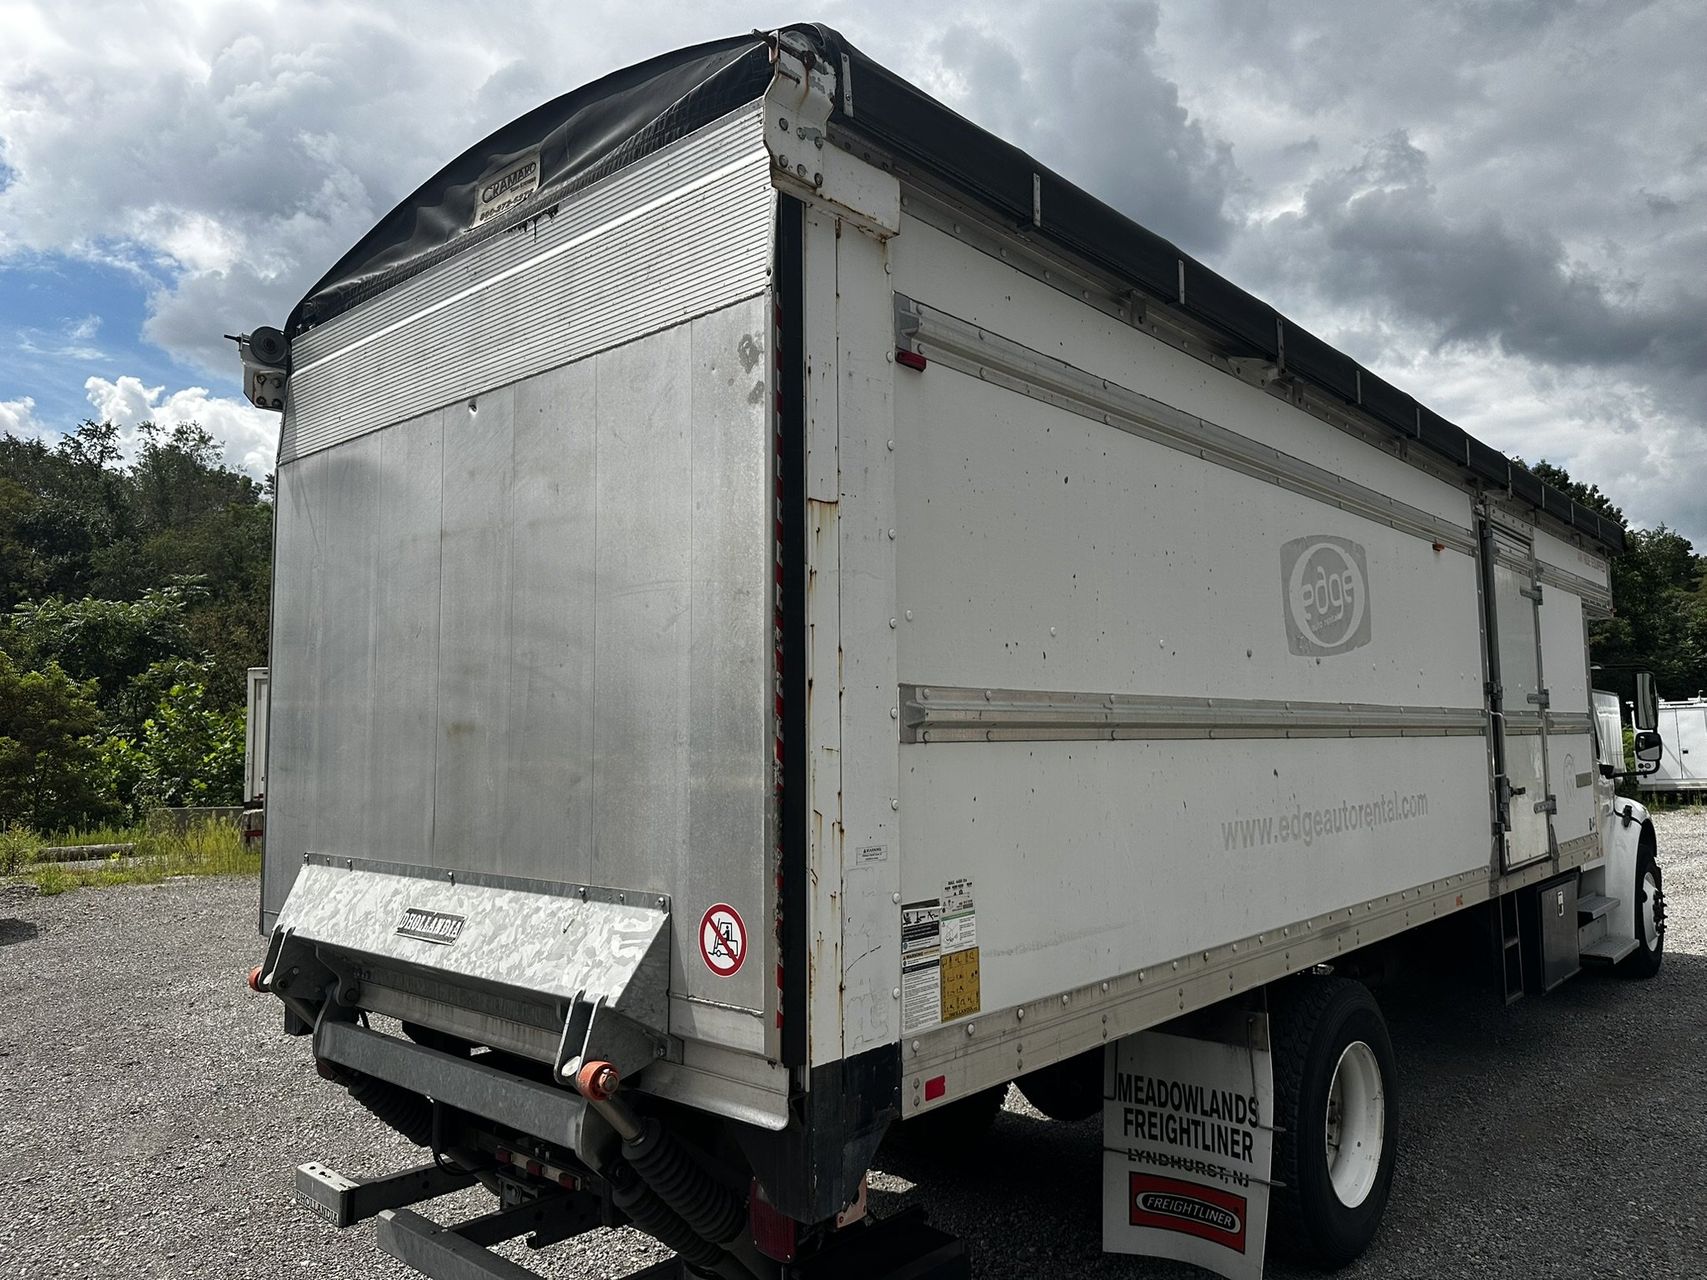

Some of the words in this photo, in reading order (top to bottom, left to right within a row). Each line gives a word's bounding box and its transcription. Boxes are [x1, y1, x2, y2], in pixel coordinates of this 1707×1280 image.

[482, 161, 537, 204] CRAMARO
[1301, 566, 1354, 620] edge
[1221, 790, 1428, 851] www.edgeautorental.com
[398, 912, 462, 938] DHOLLANDIA
[1117, 1072, 1260, 1128] MEADOWLANDS
[1123, 1107, 1254, 1164] FREIGHTLINER
[1127, 1148, 1229, 1184] LYNDHURST,
[1233, 1170, 1250, 1188] NJ
[296, 1190, 339, 1225] DHOLLANDIA
[1146, 1197, 1233, 1228] FREIGHTLINER
